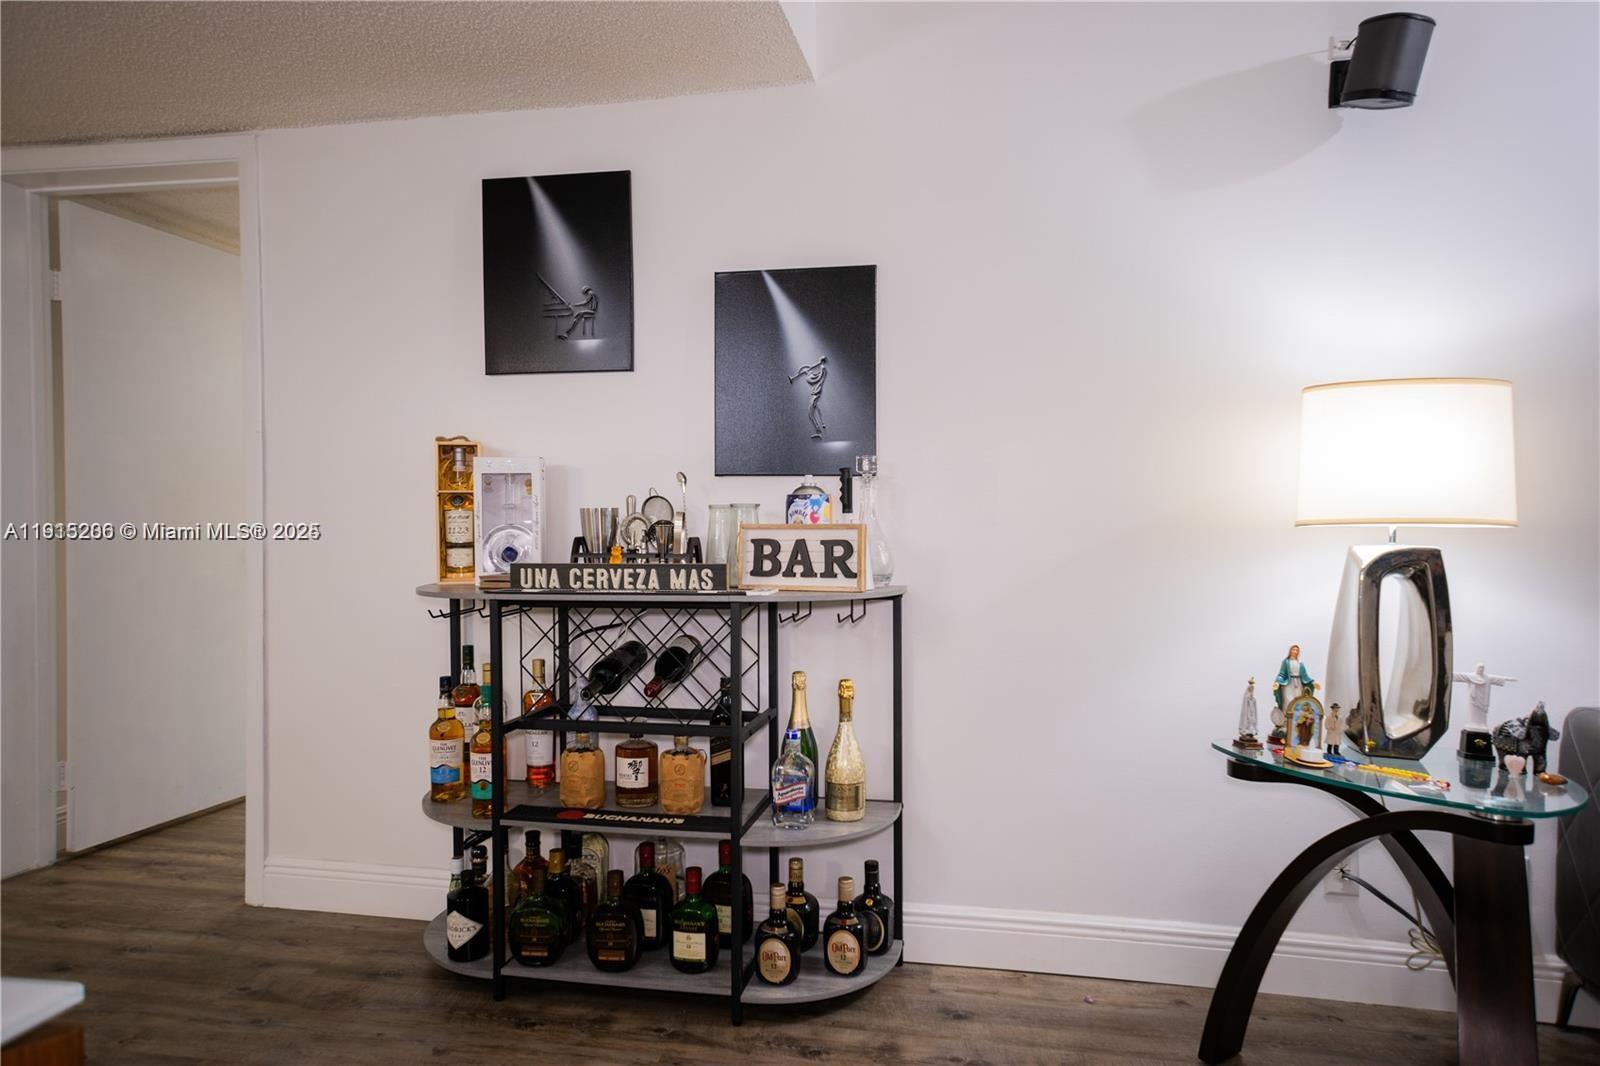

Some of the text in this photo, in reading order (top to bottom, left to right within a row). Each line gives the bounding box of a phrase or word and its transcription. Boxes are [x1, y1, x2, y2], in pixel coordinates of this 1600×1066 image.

[750, 538, 858, 578] BAR
[519, 567, 714, 590] UNA CERVEZA MAS
